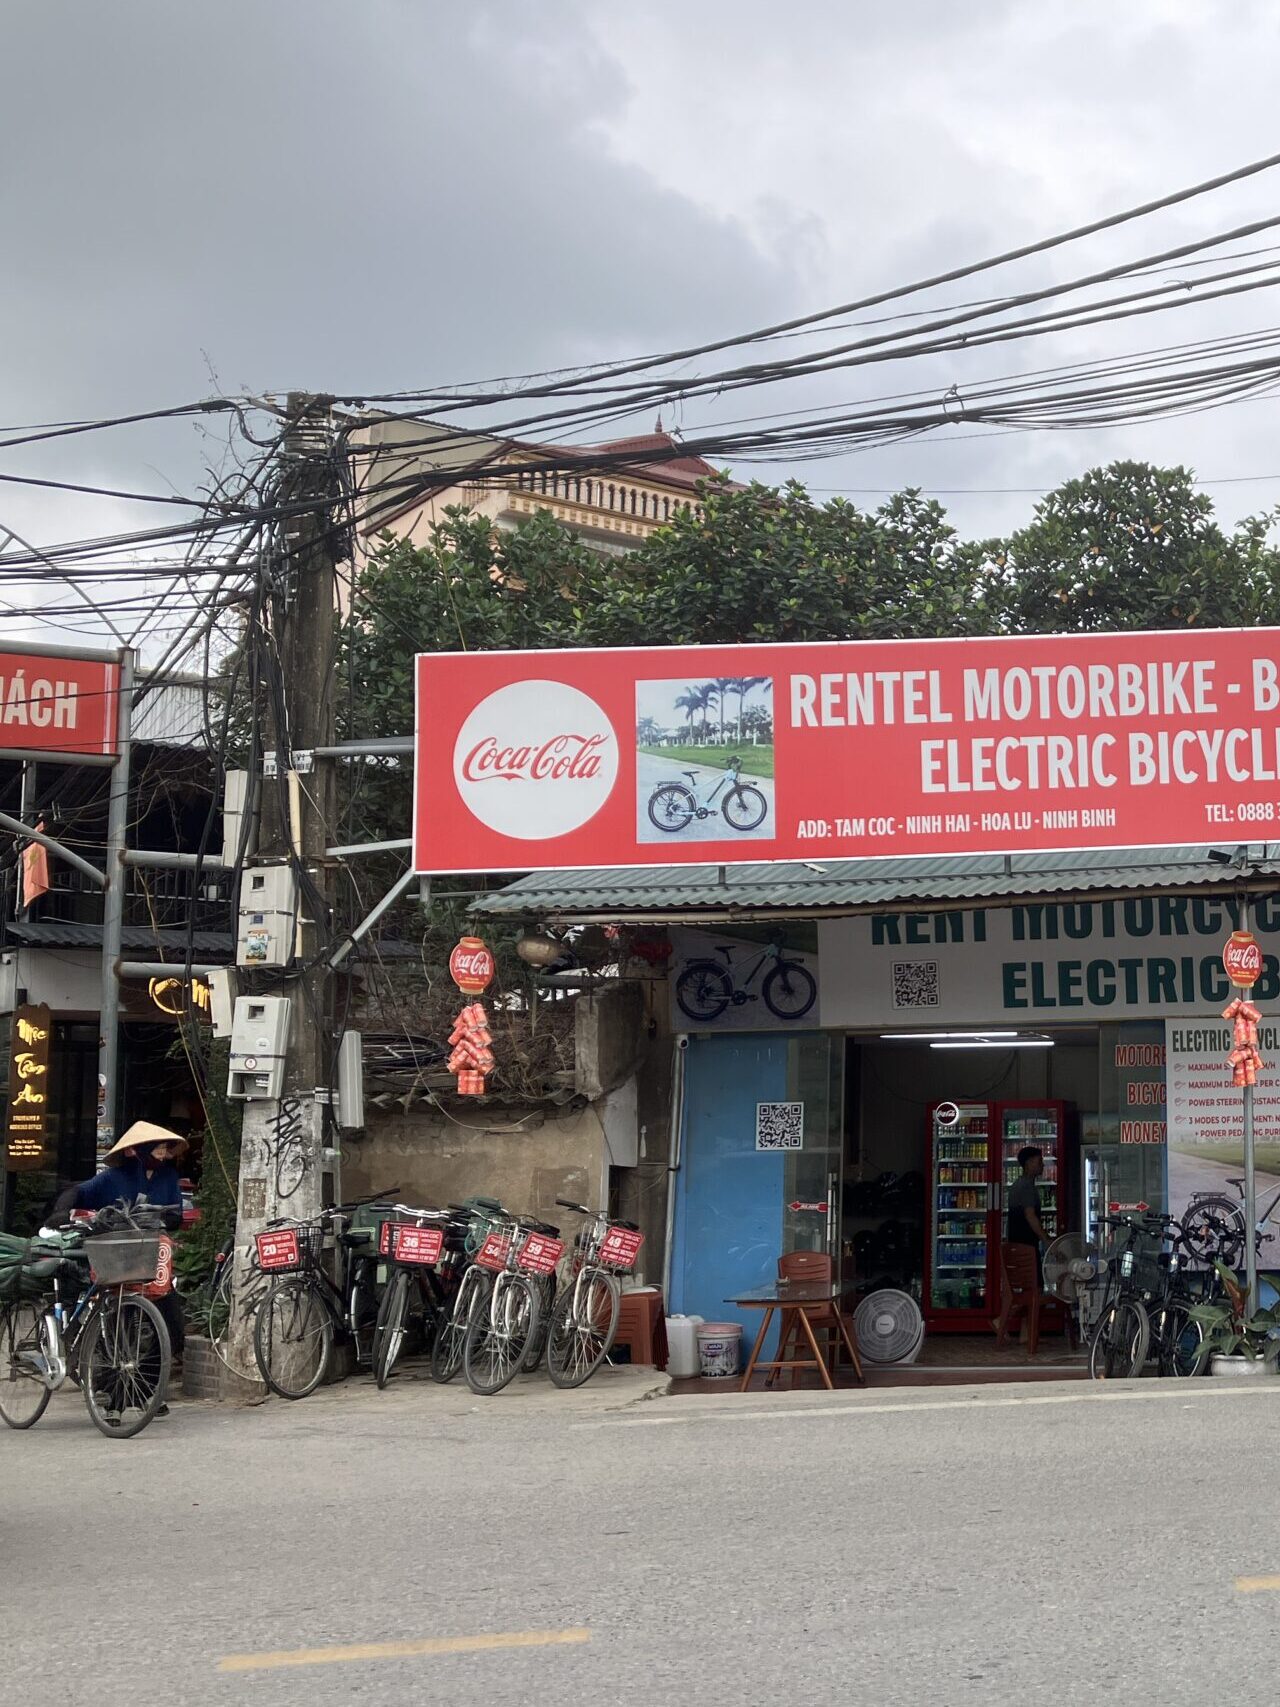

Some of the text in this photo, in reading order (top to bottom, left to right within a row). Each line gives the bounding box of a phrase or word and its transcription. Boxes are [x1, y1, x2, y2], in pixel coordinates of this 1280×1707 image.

[790, 670, 953, 728] RENTEL
[964, 661, 1218, 722] MOTORBIKE
[462, 734, 609, 782] Coca-Cola
[920, 733, 1118, 794] ELECTRIC
[1204, 804, 1235, 823] TEL:
[1237, 802, 1275, 822] 0888
[797, 818, 832, 839] ADD:
[835, 817, 866, 837] TAM
[867, 816, 896, 836] COC
[906, 814, 942, 834] NINH
[945, 813, 971, 833] HAI
[981, 812, 1012, 832] HOA
[1014, 811, 1032, 831] LU
[1042, 810, 1079, 830] NINH
[1081, 808, 1116, 828] BINH
[871, 910, 988, 946] RENT
[1002, 955, 1230, 1010] ELECTRIC
[1172, 1028, 1231, 1053] ELECTRIC
[1187, 1063, 1222, 1072] MAXIMUM
[1188, 1081, 1223, 1089] MAXIMUM
[1260, 1079, 1274, 1088] PER
[1188, 1098, 1215, 1107] POWER
[1216, 1097, 1245, 1106] STEERIN
[1188, 1116, 1193, 1125] 3
[1194, 1116, 1220, 1125] MODES
[1221, 1115, 1231, 1124] OF
[1120, 1121, 1167, 1144] MONEY
[1200, 1129, 1227, 1138] POWER
[402, 1236, 419, 1248] 36
[526, 1242, 543, 1255] 59
[607, 1236, 621, 1248] 49
[262, 1243, 277, 1256] 20
[484, 1244, 499, 1257] 54
